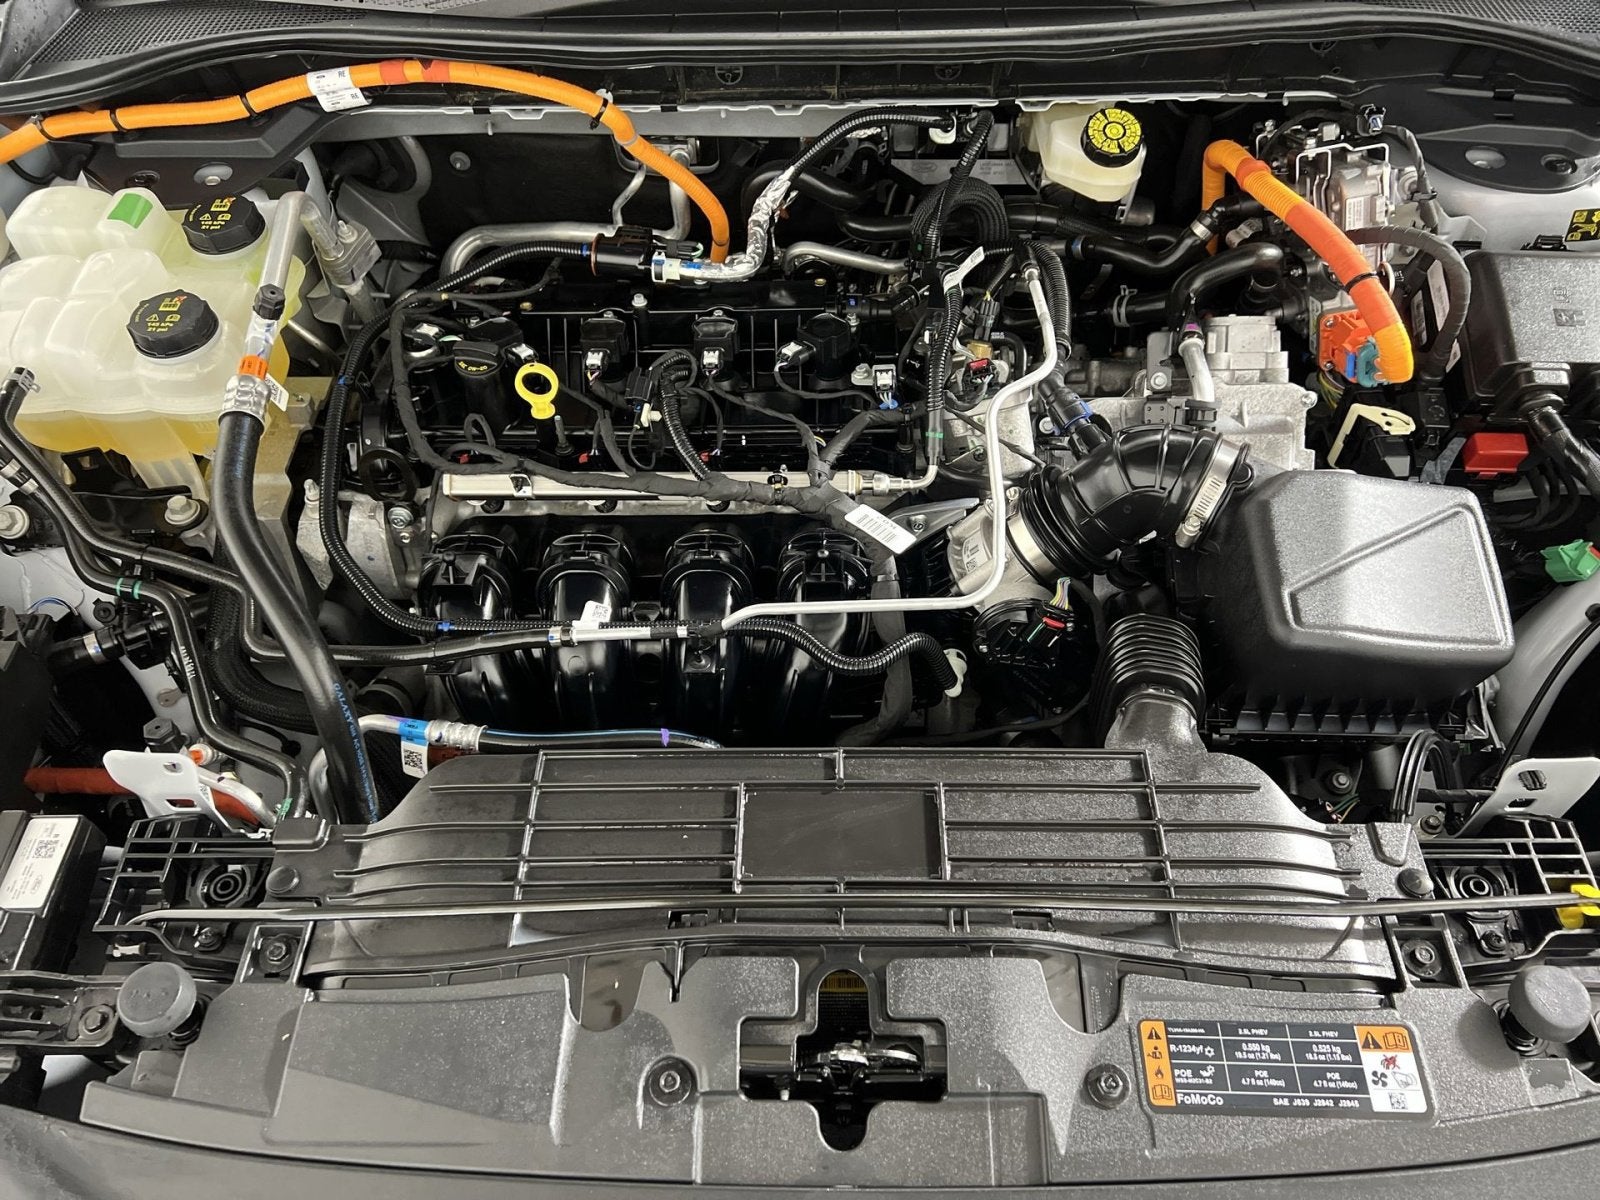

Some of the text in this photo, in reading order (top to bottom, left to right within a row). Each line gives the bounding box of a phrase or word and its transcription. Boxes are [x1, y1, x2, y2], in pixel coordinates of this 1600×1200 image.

[334, 683, 355, 724] GALAXY
[1170, 1044, 1204, 1055] R-1234yf
[1261, 1043, 1271, 1054] kg
[1332, 1045, 1342, 1054] kg
[1174, 1069, 1193, 1077] POE
[1326, 1072, 1341, 1080] POE
[1264, 1079, 1286, 1087] (140cc)
[1313, 1080, 1322, 1088] 4.7
[1177, 1093, 1224, 1105] FoMoCo
[1273, 1098, 1290, 1106] SAE
